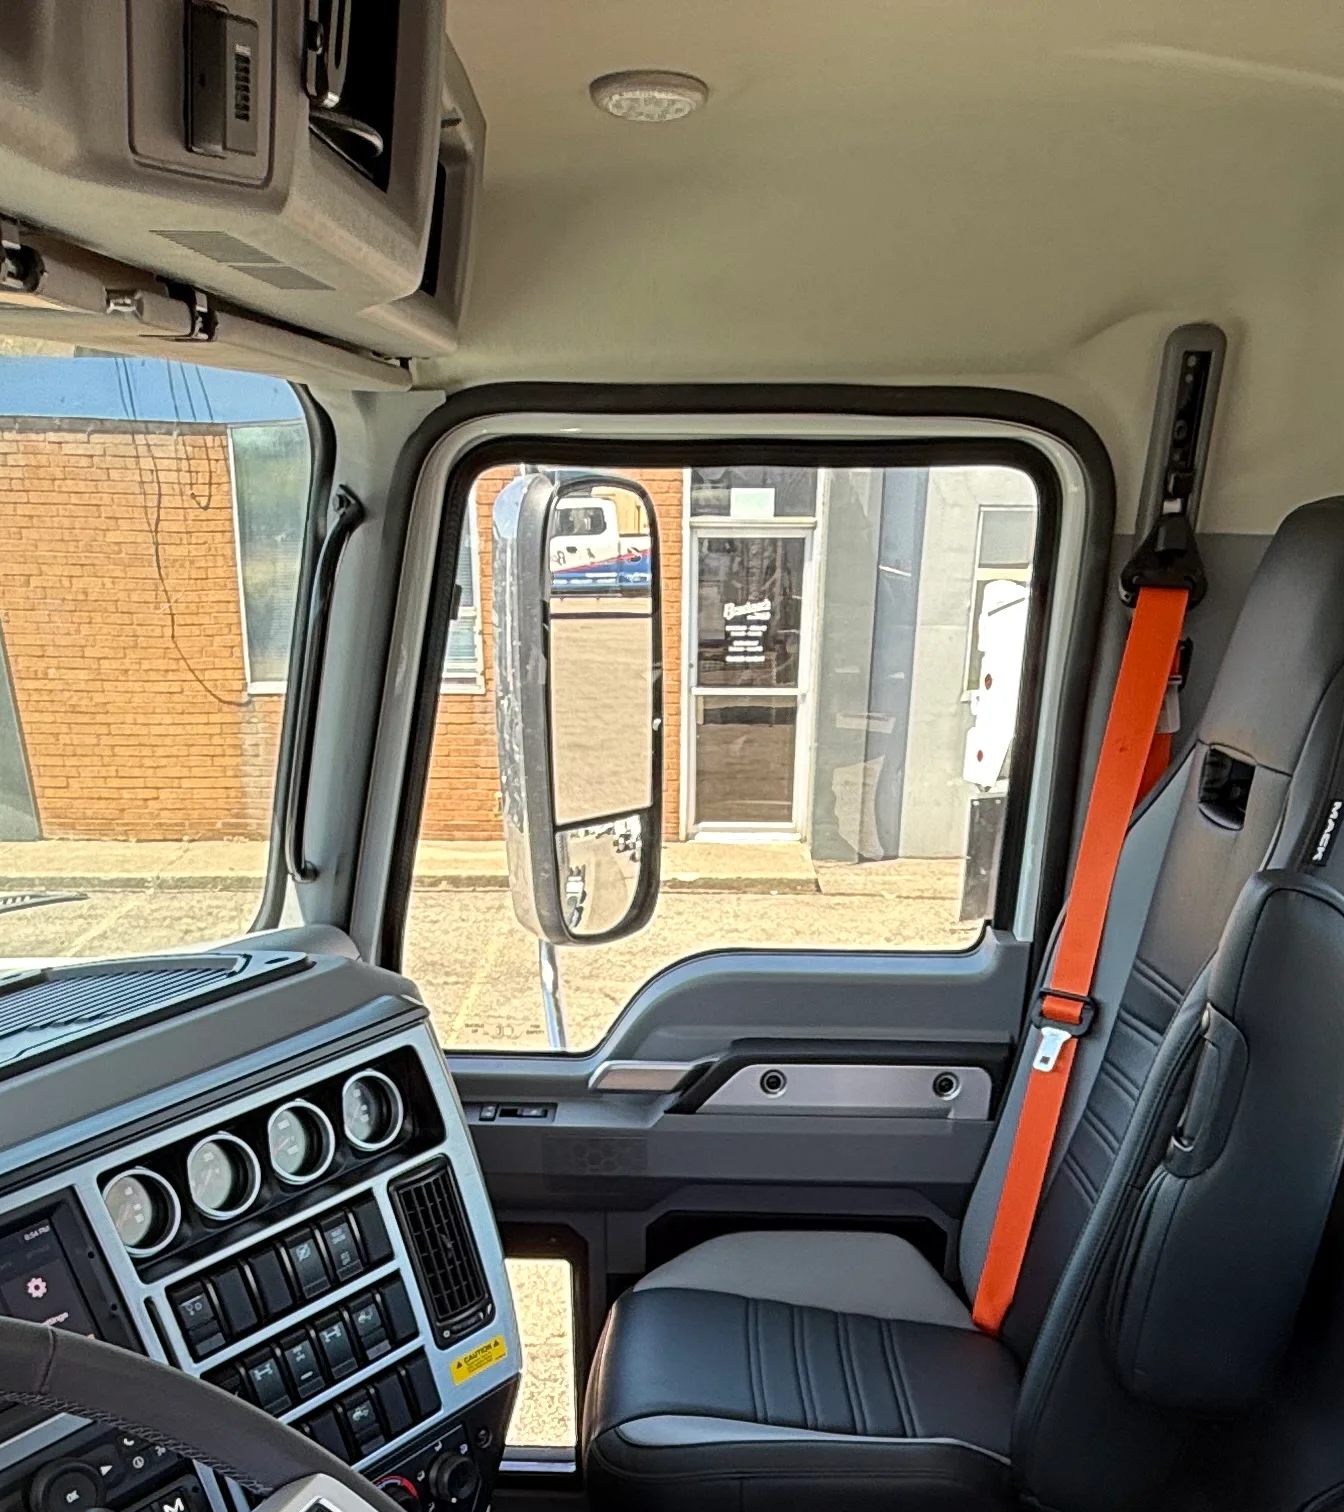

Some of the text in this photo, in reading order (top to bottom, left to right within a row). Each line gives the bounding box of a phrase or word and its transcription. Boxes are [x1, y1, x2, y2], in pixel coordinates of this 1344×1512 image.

[1311, 801, 1343, 861] MACK
[463, 1343, 493, 1363] CAUTION
[65, 1489, 81, 1504] OK
